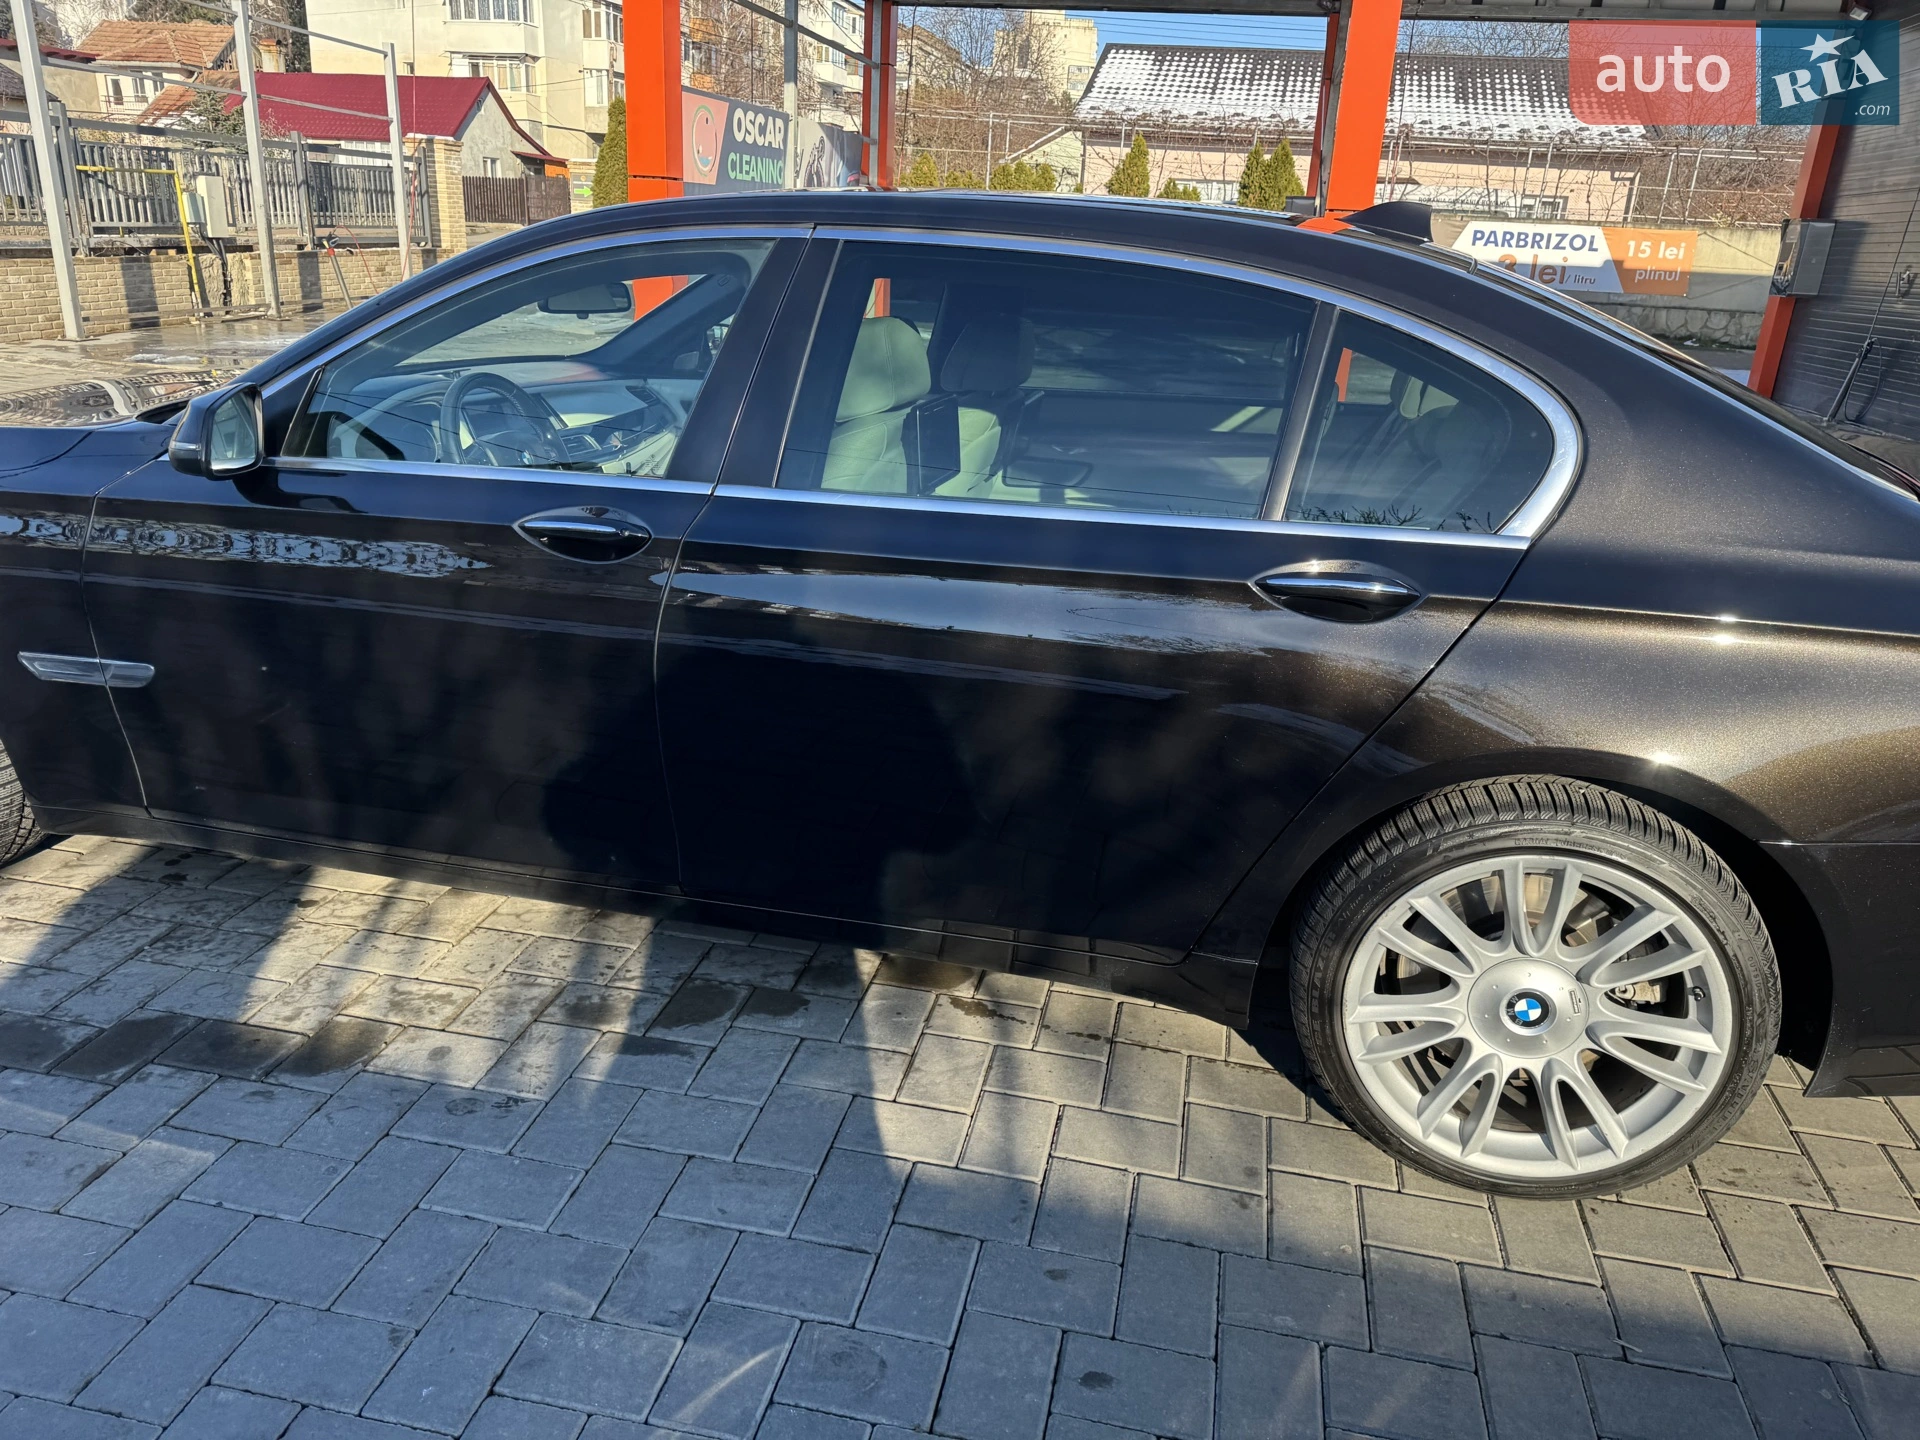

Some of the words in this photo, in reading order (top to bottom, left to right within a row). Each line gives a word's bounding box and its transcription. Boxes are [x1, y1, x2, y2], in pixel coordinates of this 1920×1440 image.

[733, 107, 784, 149] OSCAR
[1471, 229, 1599, 252] PARBRIZOL
[1627, 240, 1652, 258] 15
[1658, 241, 1686, 260] lei
[1634, 267, 1681, 283] plinul
